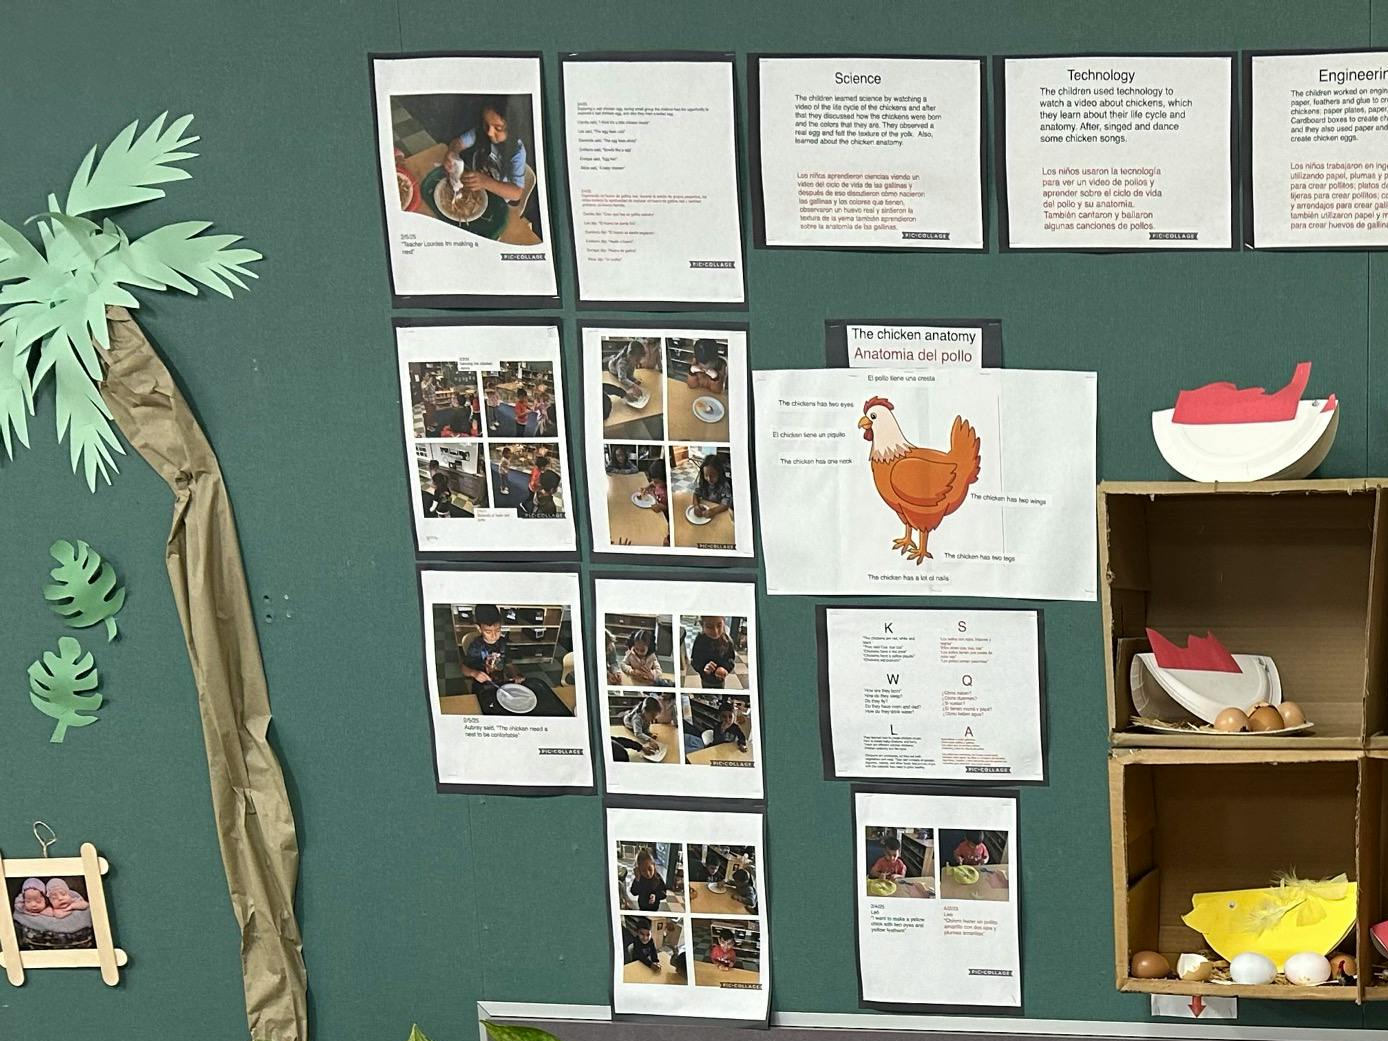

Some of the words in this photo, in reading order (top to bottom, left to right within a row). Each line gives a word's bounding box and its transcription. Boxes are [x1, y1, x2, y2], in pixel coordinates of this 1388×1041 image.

[835, 73, 881, 84] Science
[1068, 69, 1134, 83] Technology
[1040, 87, 1055, 95] The
[1058, 87, 1091, 95] children
[1094, 87, 1114, 95] used
[1117, 87, 1162, 97] technology
[1074, 99, 1097, 107] video
[1099, 99, 1123, 107] about
[1125, 99, 1165, 107] chickens,
[1168, 99, 1192, 107] which
[1040, 111, 1057, 120] they
[1060, 111, 1080, 119] learn
[1109, 110, 1128, 118] their
[1130, 110, 1142, 118] life
[1145, 111, 1167, 120] cycle
[1065, 134, 1097, 142] chicken
[1100, 135, 1127, 144] songs.
[852, 328, 873, 339] The
[877, 329, 920, 340] chicken
[925, 332, 975, 344] anatomy
[854, 348, 913, 360] Anatomia
[918, 349, 936, 361] del
[941, 350, 972, 364] pollo
[885, 623, 893, 633] K
[958, 621, 966, 632] S
[887, 674, 899, 684] W
[962, 675, 972, 686] Q
[890, 724, 897, 735] L
[965, 726, 973, 737] A
